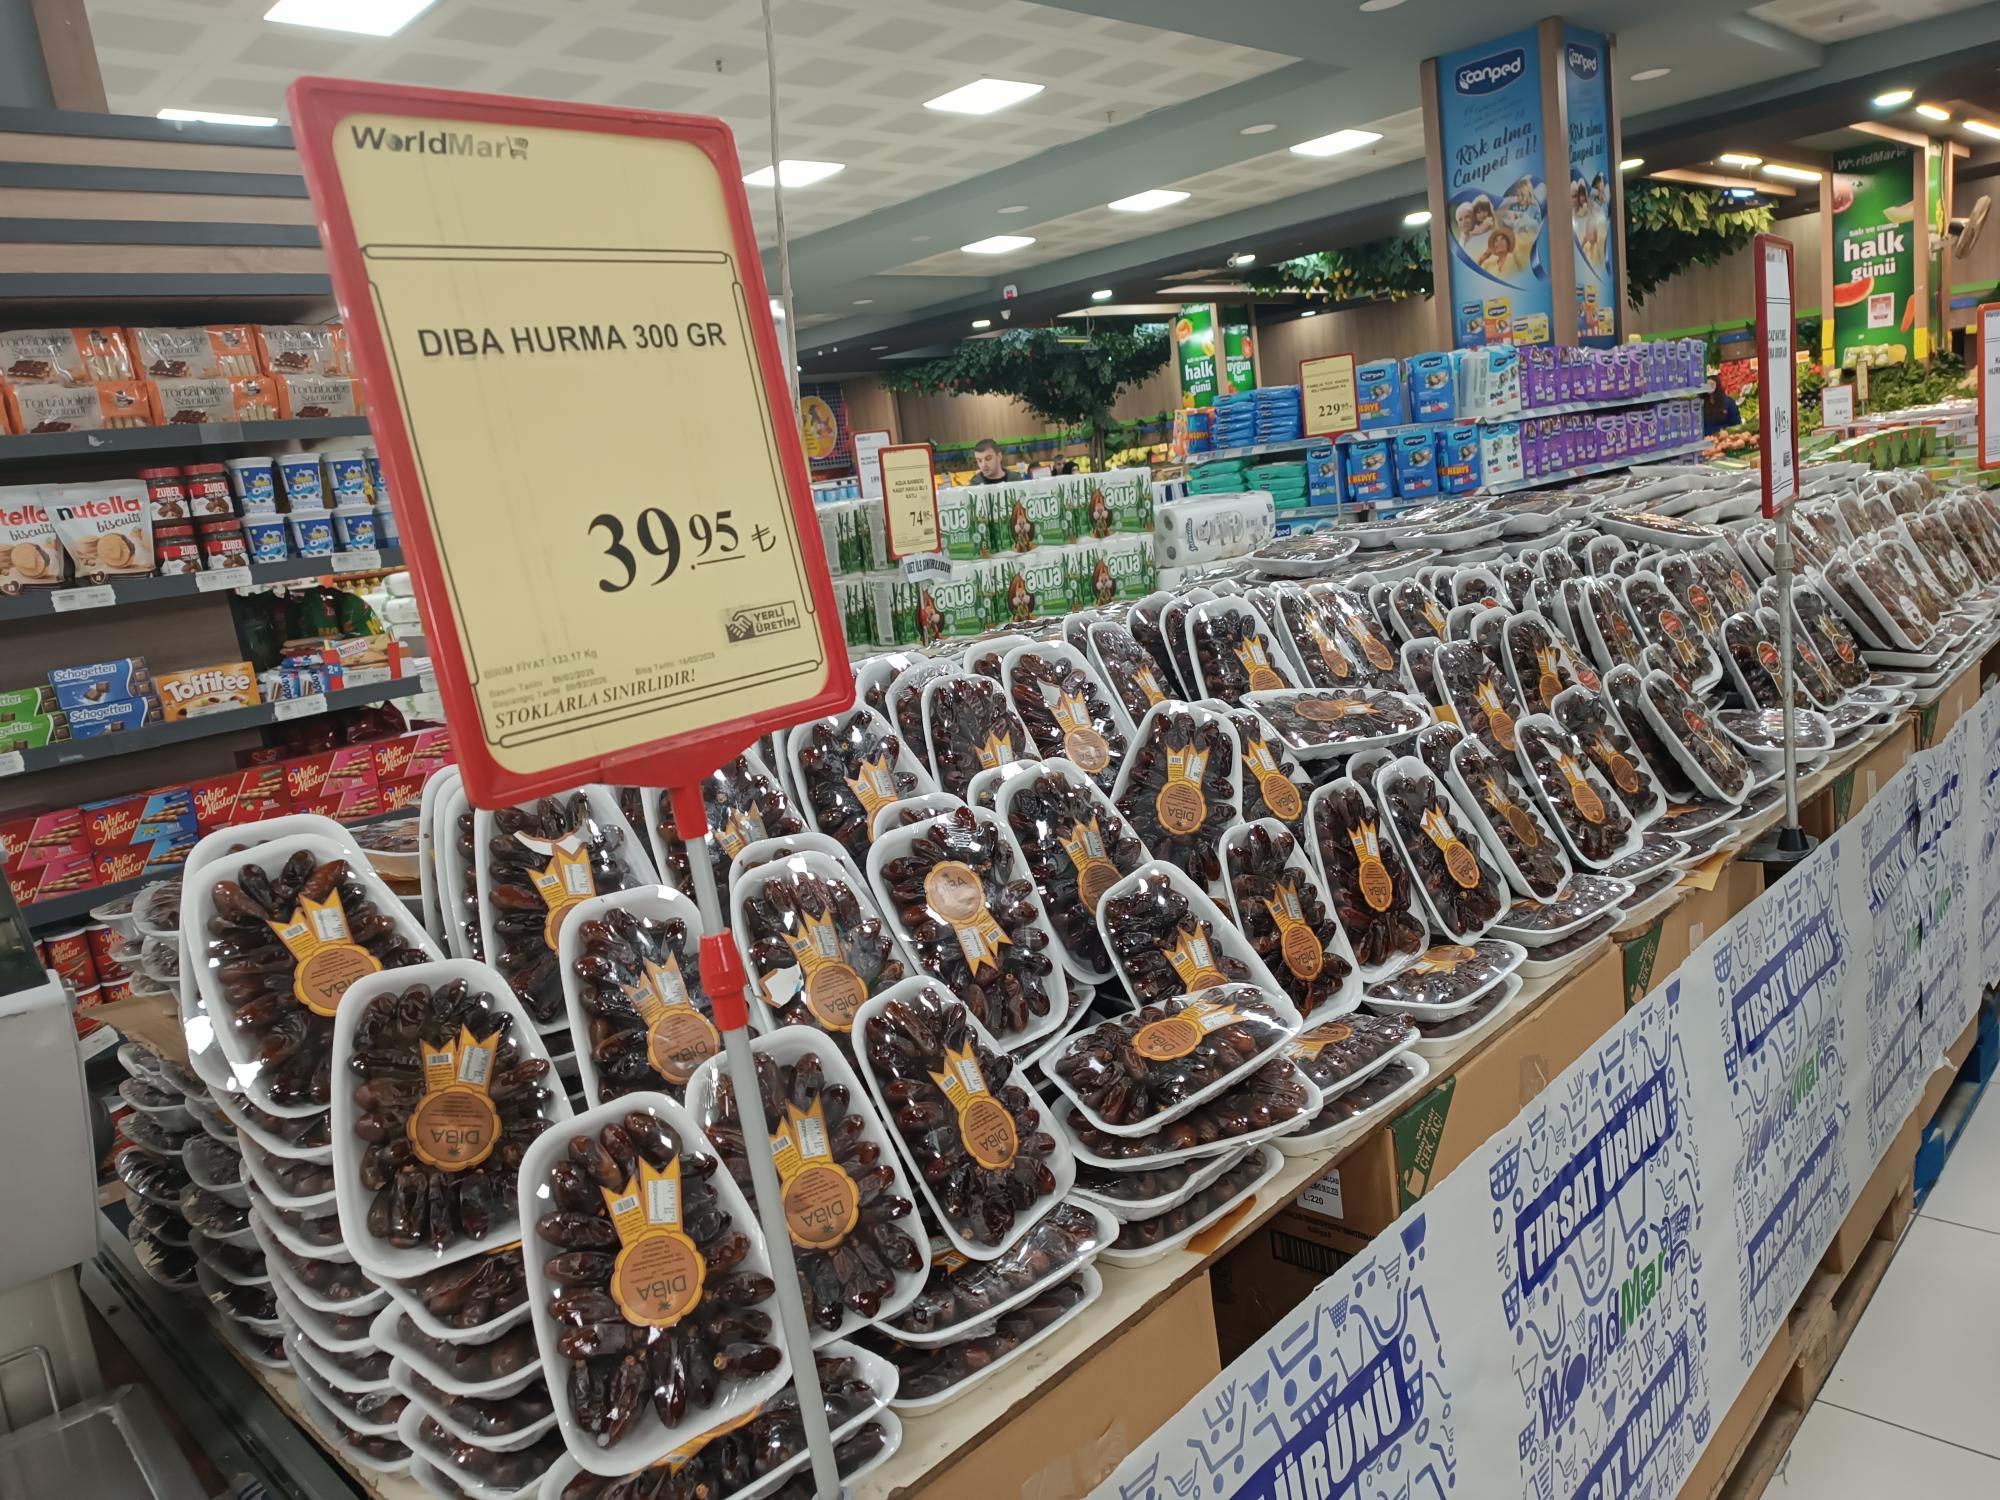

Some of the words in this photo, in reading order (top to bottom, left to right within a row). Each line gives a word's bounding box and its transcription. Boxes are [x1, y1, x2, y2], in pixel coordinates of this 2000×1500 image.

[1463, 57, 1521, 86] canped
[1494, 122, 1531, 149] alma
[1453, 147, 1508, 187] Canped
[1515, 135, 1536, 160] al!
[1844, 231, 1904, 262] halk
[1851, 258, 1896, 283] günü
[417, 328, 503, 357] DIBA
[513, 323, 627, 354] HURMA
[635, 323, 679, 349] 300
[686, 321, 727, 347] GR
[1185, 361, 1214, 381] halk
[1190, 380, 1211, 396] günü
[56, 495, 142, 521] nutella
[1027, 496, 1059, 520] aqua
[1106, 485, 1137, 507] aqua
[97, 512, 142, 534] biscuits
[1026, 566, 1062, 591] aqua
[1108, 555, 1140, 578] aqua
[935, 583, 974, 609] aqua
[753, 605, 785, 622] YERLİ
[755, 617, 796, 634] ÜRETİM
[54, 662, 117, 682] Schogetten
[163, 671, 251, 703] Toffifee
[495, 693, 600, 729] STOKLARLA
[602, 668, 697, 705] SINIRLIDIR!
[69, 703, 132, 723] Schogetten
[376, 744, 405, 764] Wafer
[378, 751, 415, 777] Master
[288, 764, 320, 785] Wafer
[290, 772, 329, 798] Master
[194, 785, 228, 807] Wafer
[197, 794, 238, 820] Master
[93, 810, 131, 831] Wafer
[1167, 805, 1194, 821] DIBA
[95, 818, 140, 846] Master
[100, 853, 137, 874] Wafer
[1736, 965, 1790, 1050] FIRSAT
[1785, 917, 1835, 998] ÜRÜNÜ
[824, 993, 858, 1015] DIBA
[431, 1128, 480, 1145] DIBA
[978, 1129, 1009, 1153] DIBA
[1419, 1142, 1437, 1171] ÇEK,
[1432, 1112, 1444, 1138] AÇ!
[1523, 1156, 1599, 1282] FIRSAT
[1600, 1080, 1667, 1194] ÜRÜNÜ
[801, 1200, 845, 1229] DIBA
[636, 1274, 688, 1302] DIBA
[1272, 1358, 1401, 1500] ÜRÜNÜ
[1626, 1355, 1688, 1478] ÜRÜNÜ
